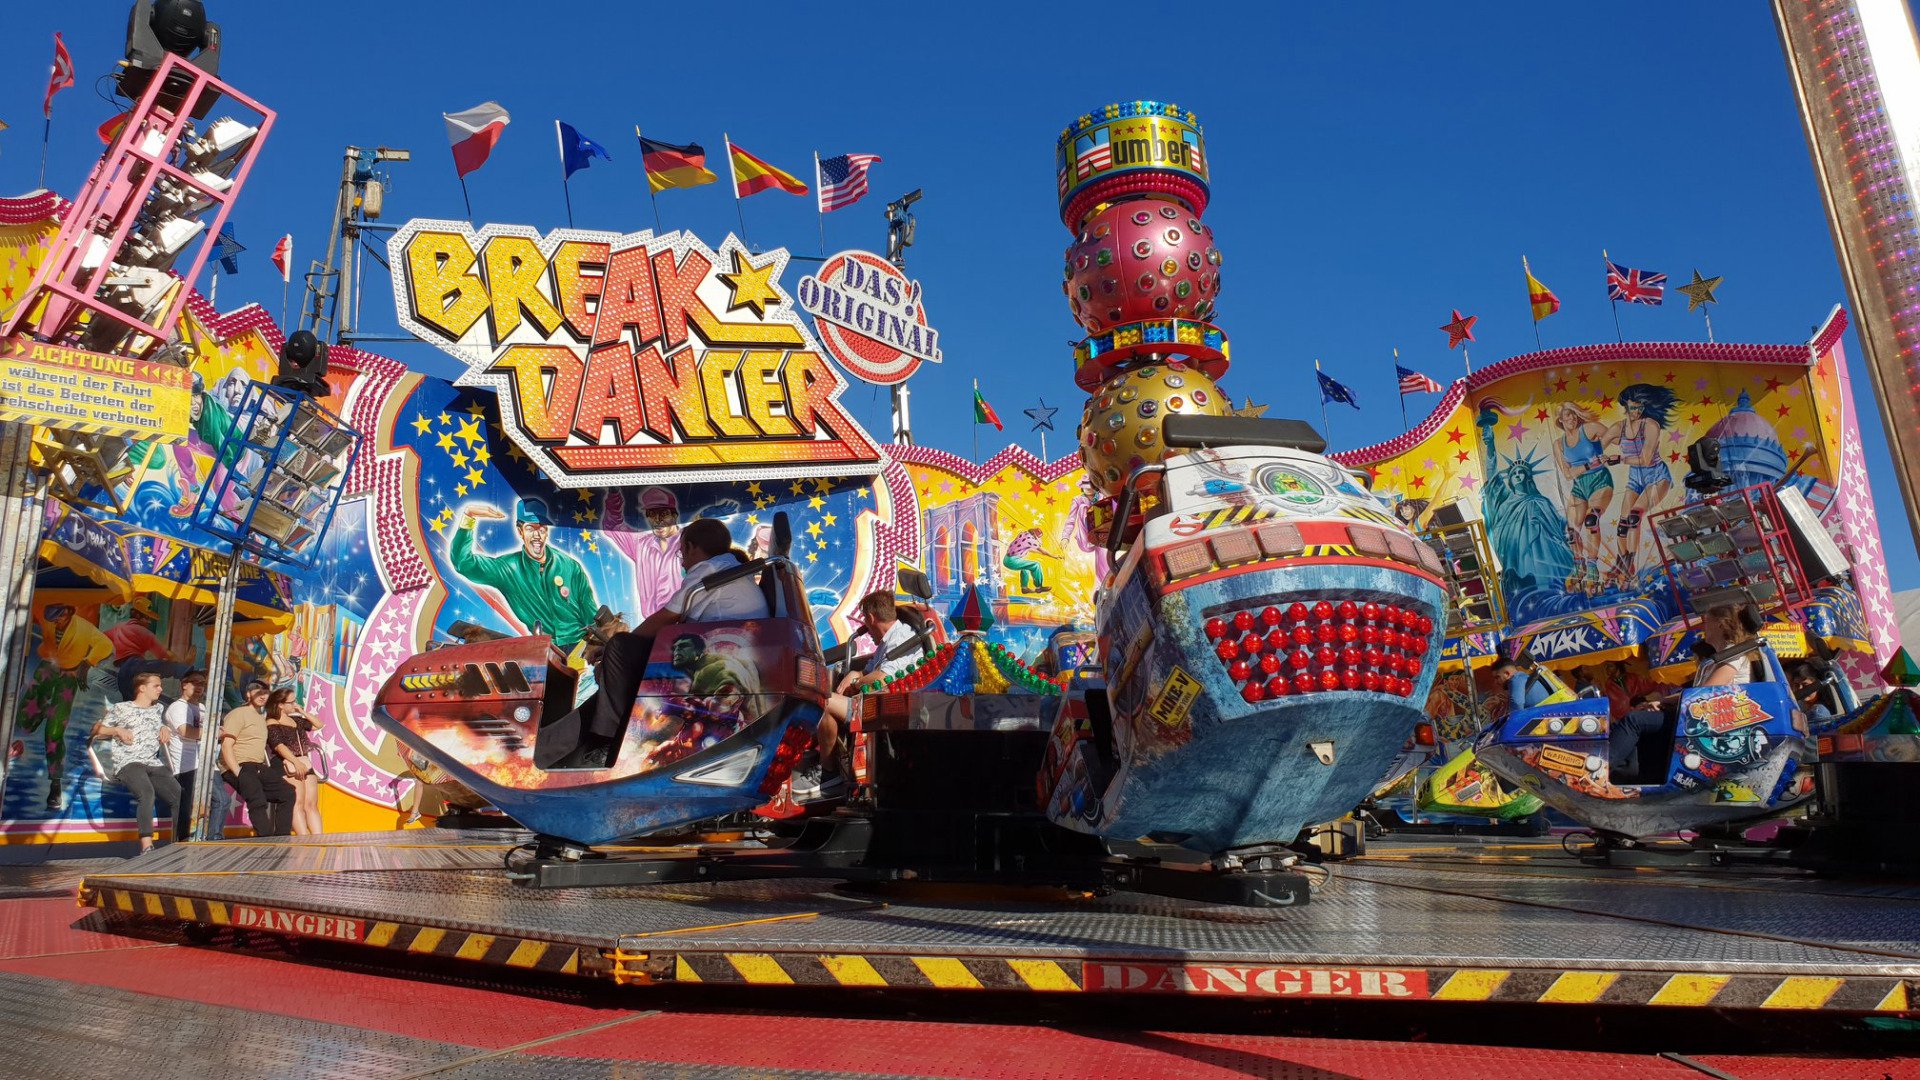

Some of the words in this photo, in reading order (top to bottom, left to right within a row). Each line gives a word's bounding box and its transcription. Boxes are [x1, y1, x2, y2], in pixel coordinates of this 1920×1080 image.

[405, 229, 806, 350] BREAK
[799, 277, 940, 360] ORIGINAL
[31, 344, 136, 377] ACHTUNG
[1, 378, 22, 392] ist
[27, 381, 55, 398] das
[60, 387, 126, 409] Betreten
[130, 398, 155, 413] der
[8, 366, 78, 387] während
[83, 376, 109, 391] der
[112, 381, 153, 398] Fahrt
[0, 394, 88, 418] rehscheibe
[92, 410, 164, 429] verboten!
[484, 340, 882, 471] DANCER
[1528, 625, 1596, 659] ATTACK
[1707, 704, 1767, 731] DANCER
[1546, 751, 1581, 765] WARNING
[238, 907, 357, 940] DANGER
[1100, 964, 1413, 998] DANGER
